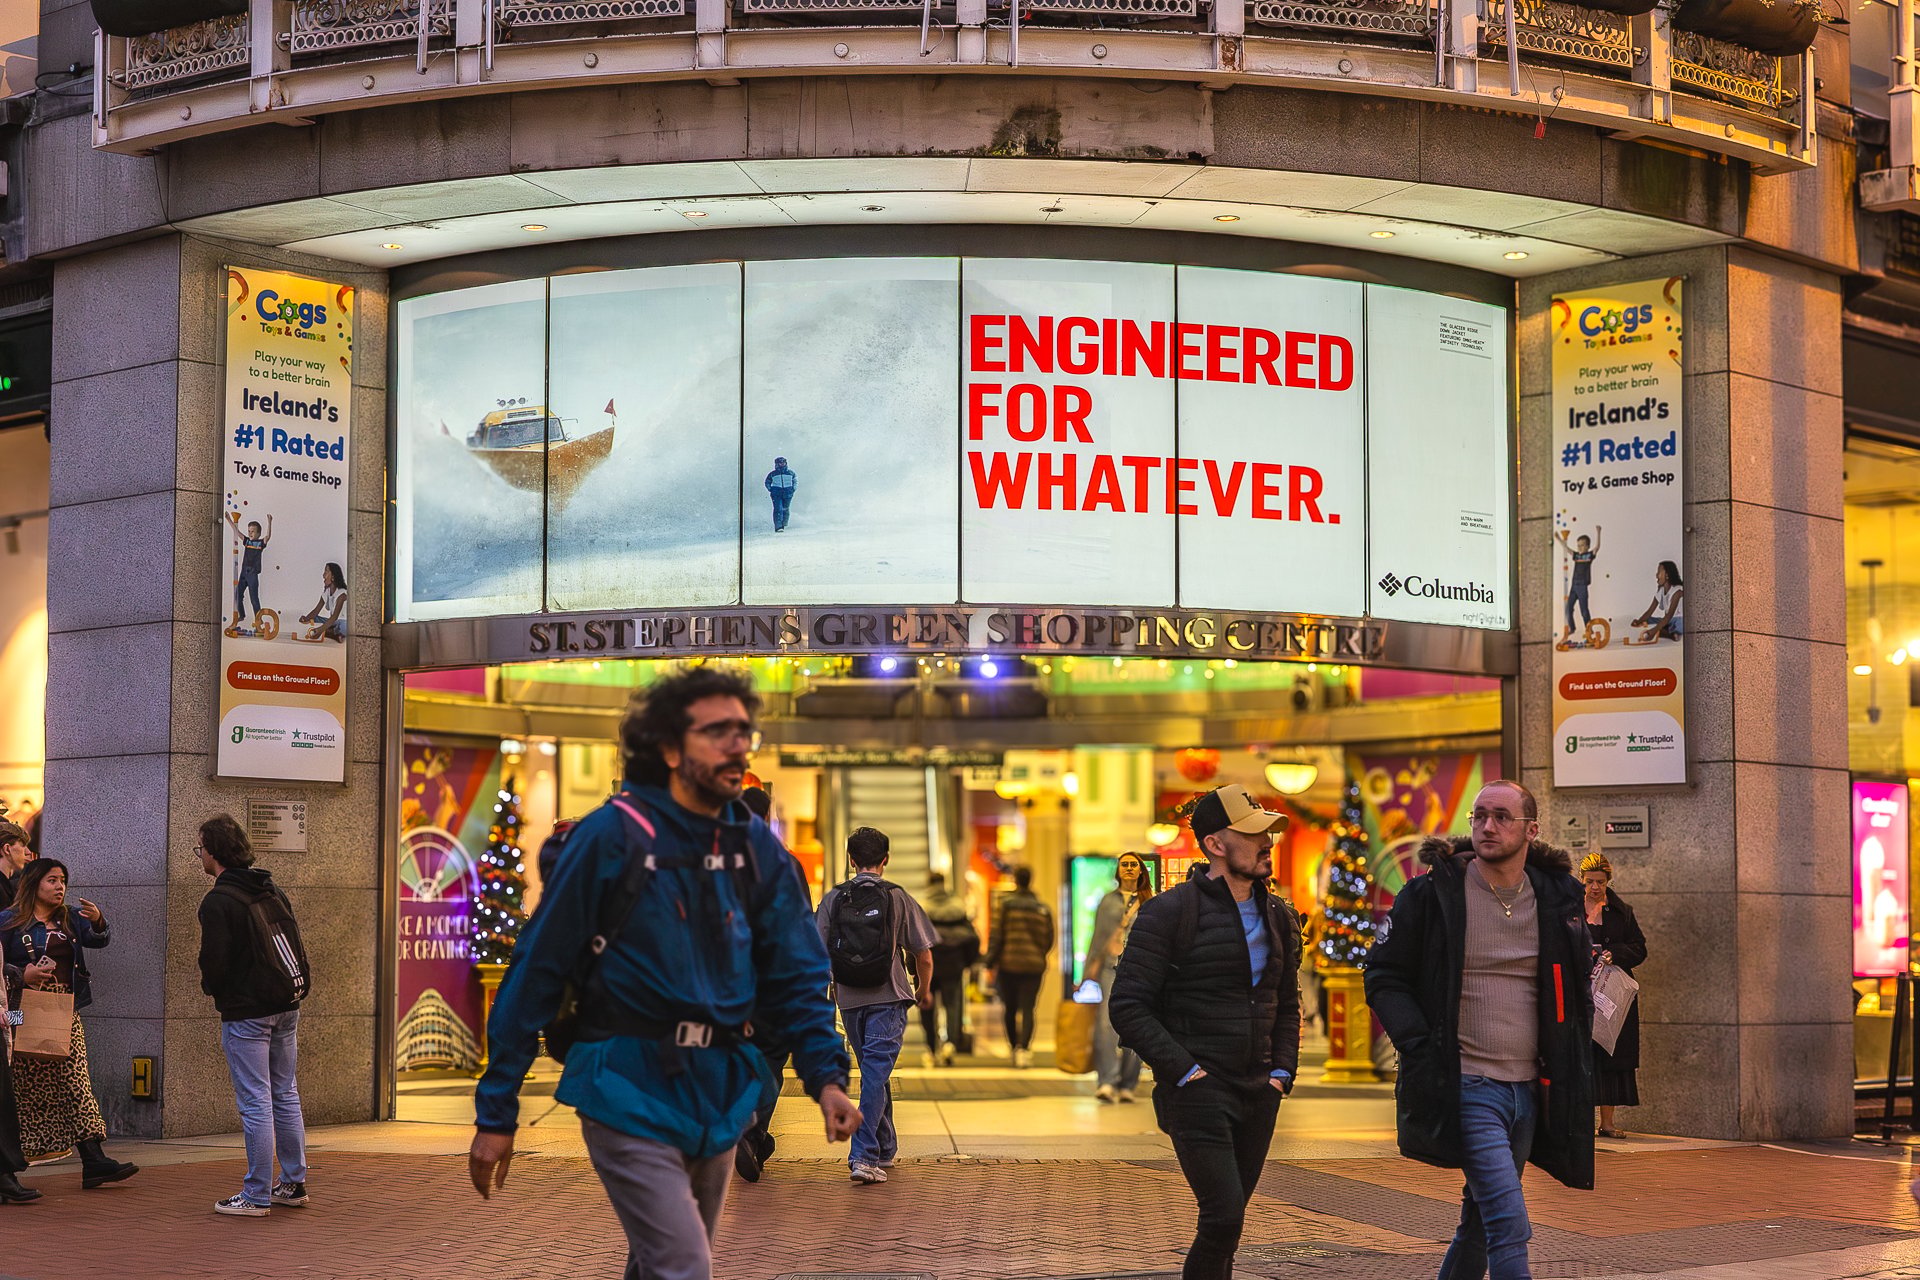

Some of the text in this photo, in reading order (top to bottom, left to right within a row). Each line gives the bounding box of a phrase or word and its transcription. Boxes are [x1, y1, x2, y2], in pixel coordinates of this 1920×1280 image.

[256, 290, 327, 329] Cogs
[1580, 304, 1653, 336] Cogs
[260, 322, 326, 342] Toys & Games
[1584, 333, 1652, 350] Toys & Games
[254, 350, 326, 374] Play your way
[970, 314, 1354, 392] ENGINEERED
[249, 366, 330, 388] to a better brain
[1579, 362, 1653, 378] Play your way
[1574, 376, 1658, 395] to a better brain
[243, 388, 338, 422] Ireland's
[968, 383, 1094, 444] FOR
[1569, 398, 1669, 428] Ireland's
[234, 424, 344, 461] #1 Rated
[1562, 430, 1676, 467] #1 Rated
[234, 461, 342, 489] Toy & Game Shop
[967, 451, 1340, 525] WHATEVER.
[1562, 472, 1674, 494] Toy & Game Shop
[1404, 576, 1494, 604] Columbia
[814, 613, 973, 646] GREEN
[988, 612, 1216, 649] SHOPPING
[1225, 619, 1384, 656] CENTRE
[238, 672, 252, 680] Find
[285, 676, 309, 684] Ground
[310, 677, 330, 686] Floor!
[1618, 680, 1643, 688] Ground
[1645, 678, 1666, 686] Floor!
[303, 732, 335, 742] Trustpilot
[1638, 734, 1674, 744] Trustpilot
